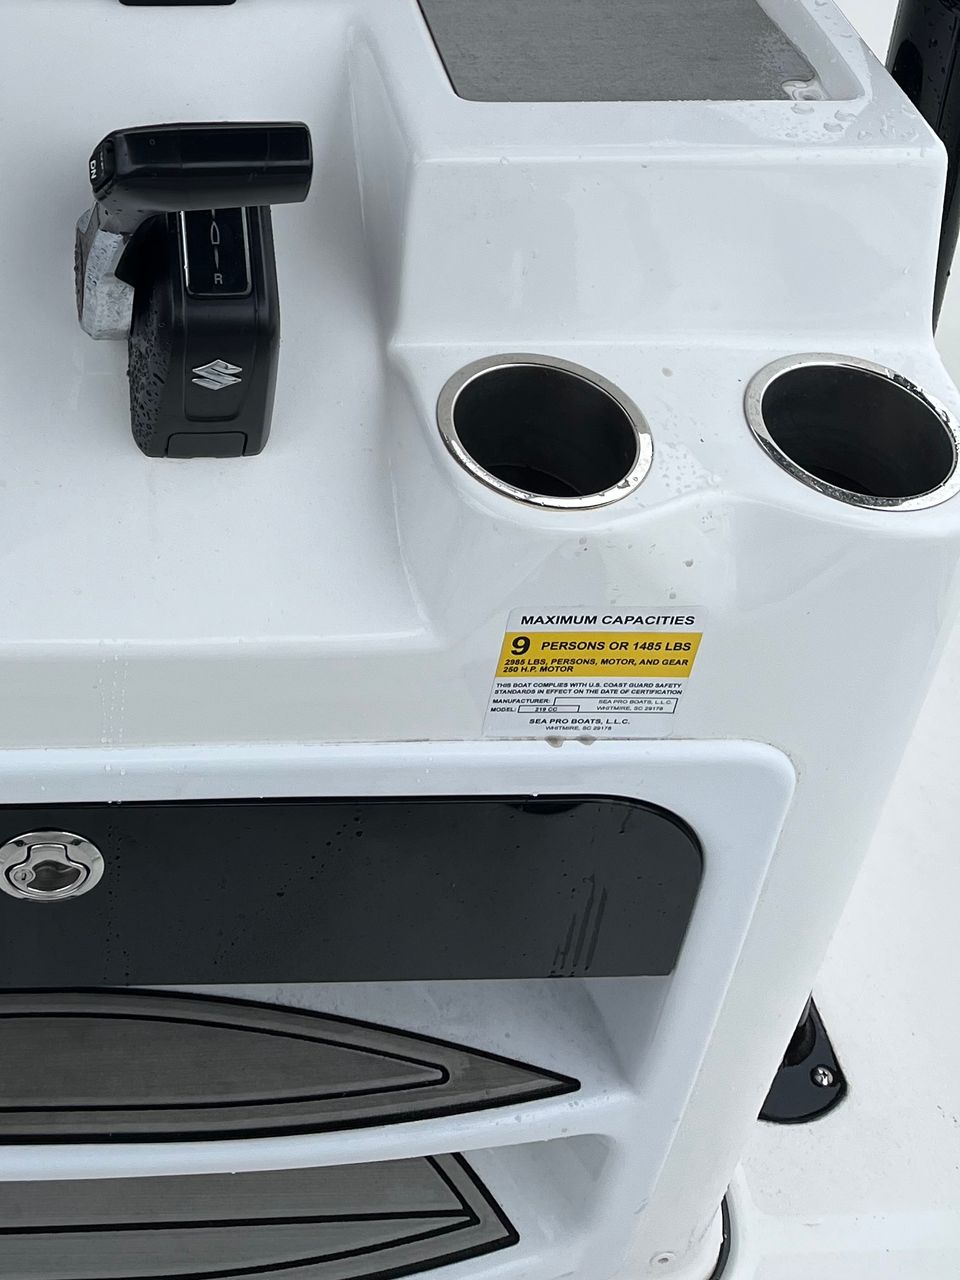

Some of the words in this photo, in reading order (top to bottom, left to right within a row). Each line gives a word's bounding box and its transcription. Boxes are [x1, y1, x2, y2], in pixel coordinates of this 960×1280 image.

[214, 274, 223, 285] R
[520, 615, 597, 625] MAXIMUM
[601, 615, 695, 625] CAPACITIES
[511, 636, 531, 655] 9
[541, 641, 605, 651] PERSONS
[609, 641, 629, 651] OR
[633, 641, 662, 651] 1485
[665, 642, 692, 651] LBS
[527, 658, 548, 666] LBS,
[551, 658, 598, 666] PERSONS,
[600, 658, 637, 666] MOTOR,
[639, 658, 660, 666] AND
[661, 658, 688, 666] GEAR
